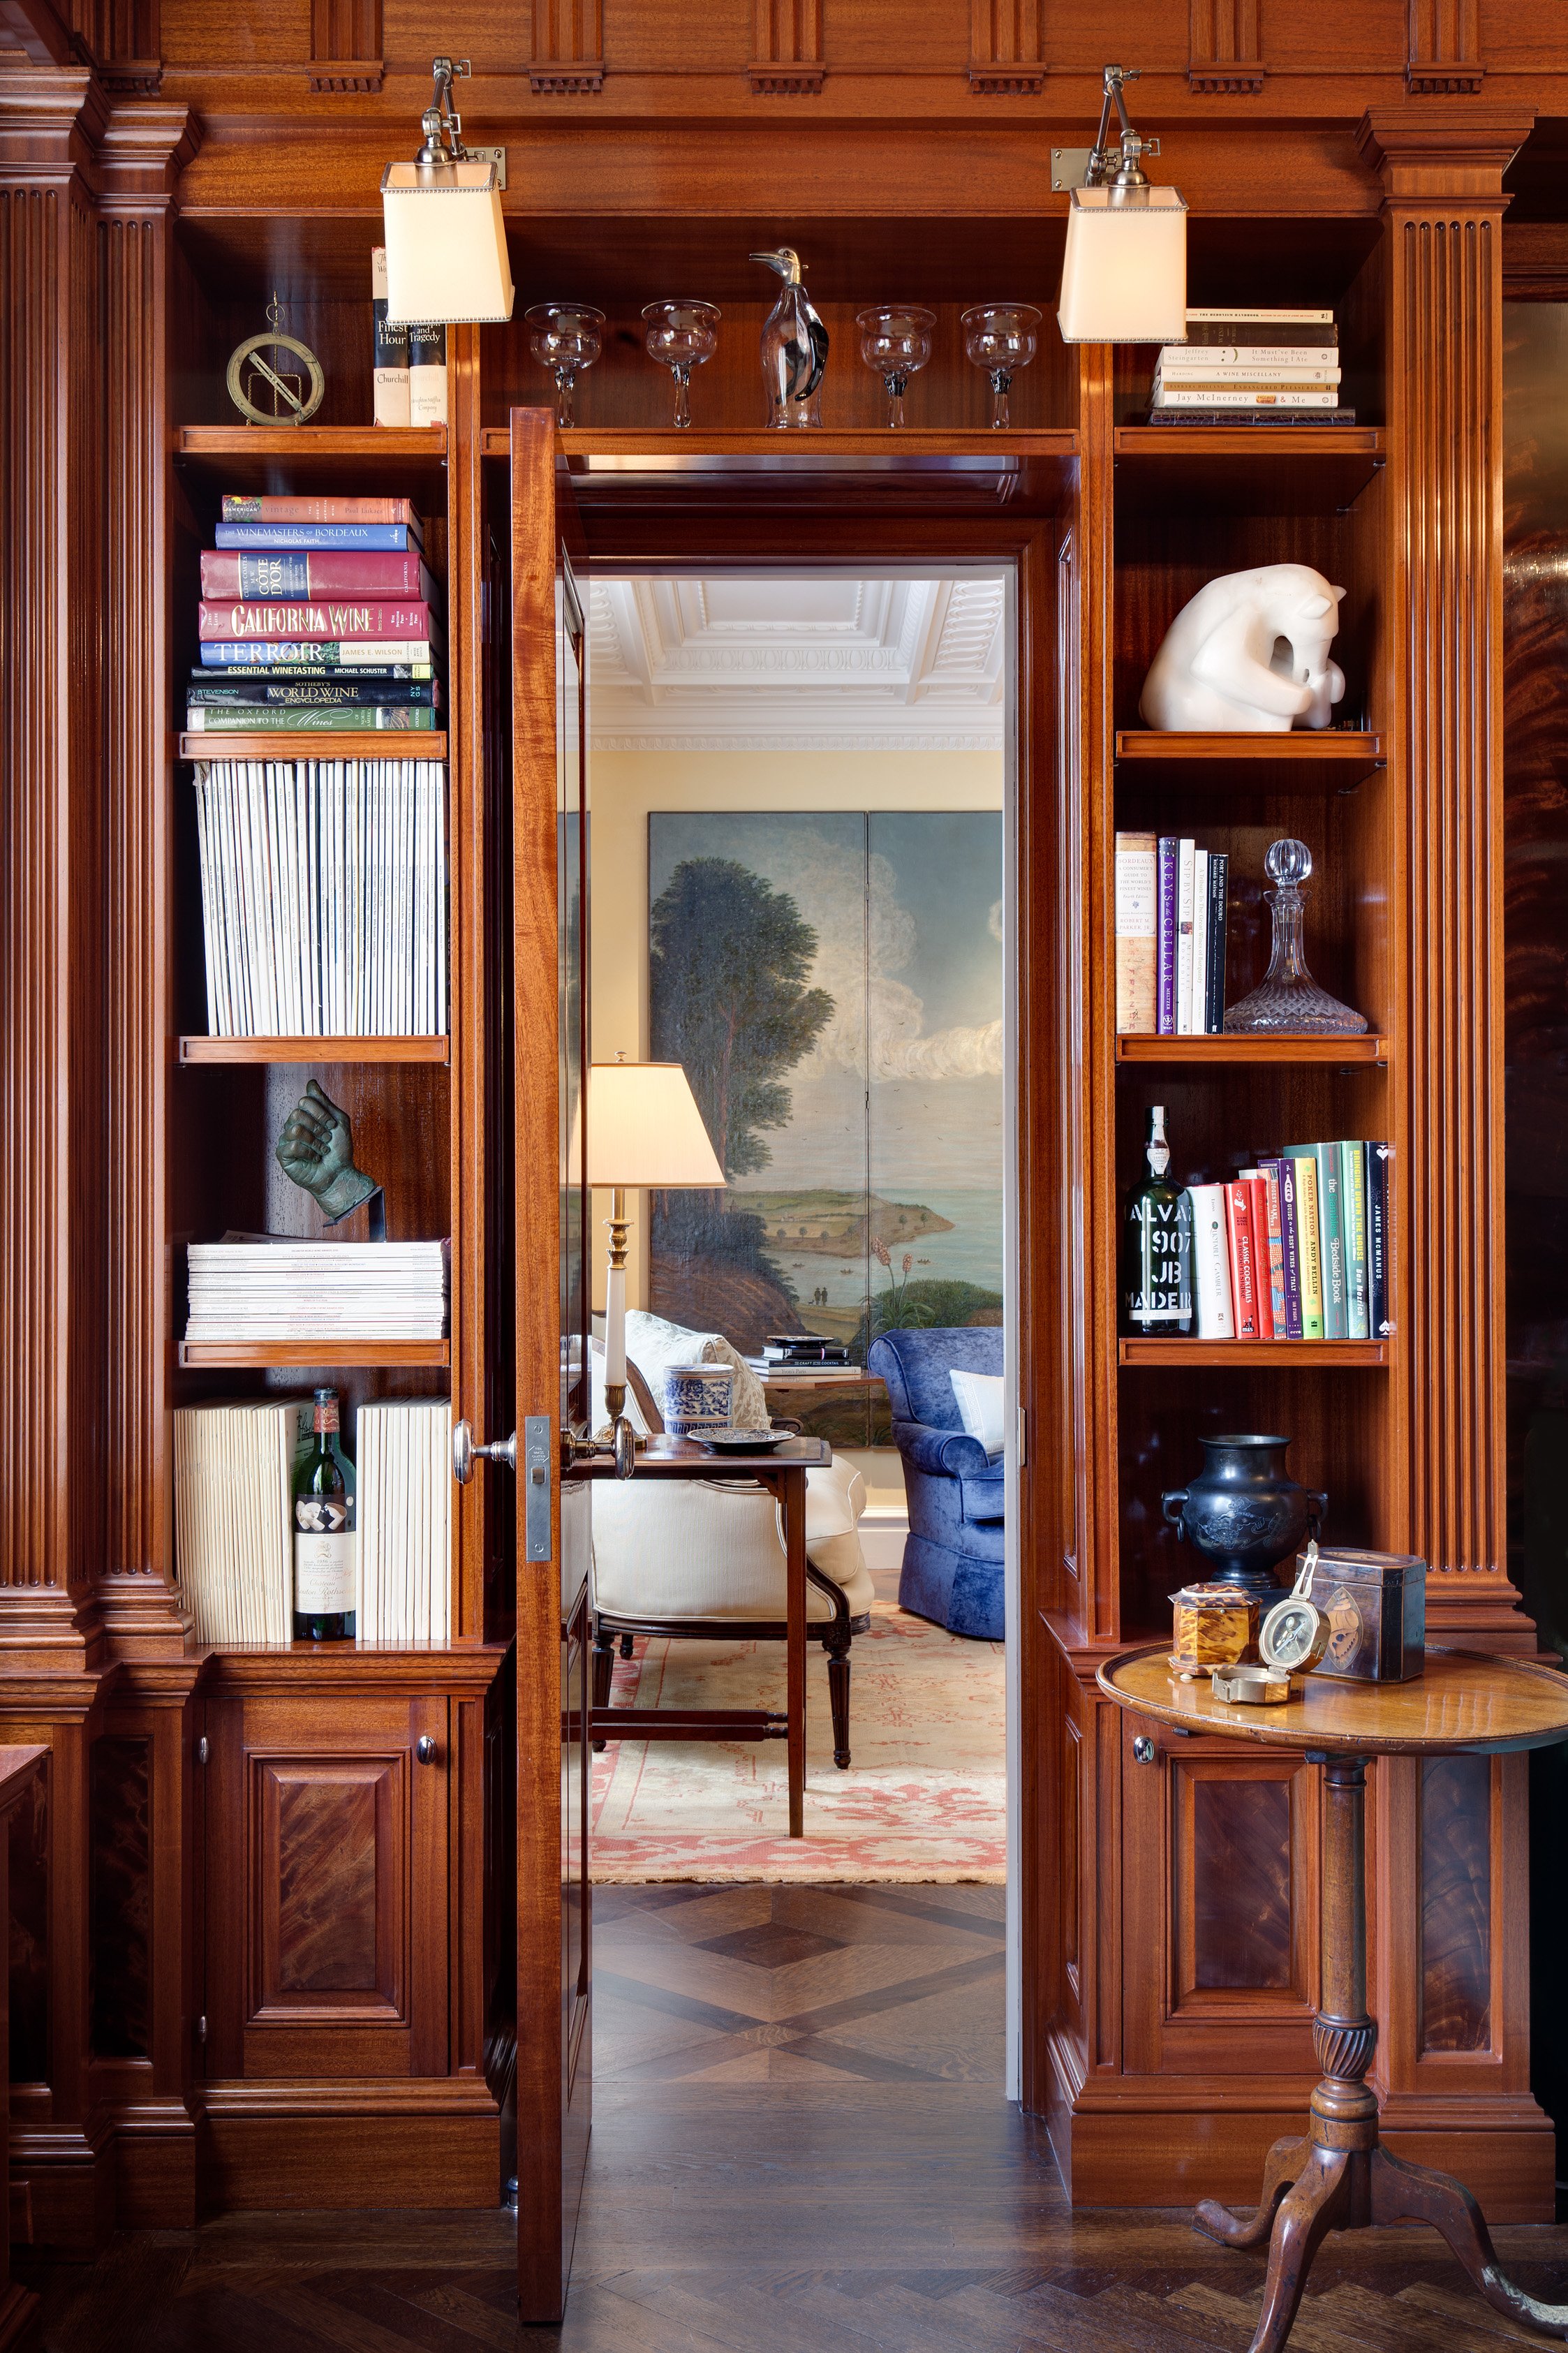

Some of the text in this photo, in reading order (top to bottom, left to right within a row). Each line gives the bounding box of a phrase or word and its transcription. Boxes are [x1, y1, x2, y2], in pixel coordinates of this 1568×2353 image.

[379, 333, 406, 345] Hour
[409, 331, 441, 343] Tragedy
[377, 374, 409, 384] Churchill
[1176, 393, 1192, 403] Jay
[1197, 394, 1249, 404] McInerney
[265, 506, 300, 517] vintage
[236, 529, 306, 537] WINEMASTERS
[315, 529, 369, 538] BORDEAUX
[255, 558, 269, 596] CÔTE
[269, 558, 283, 596] D'OR
[230, 605, 328, 637] CALIFORNIA
[328, 605, 374, 637] WINE
[214, 643, 325, 662] TERROIR
[228, 666, 327, 674] ESSENTIAL WINETASTING
[268, 687, 360, 698] WORLD WINE
[410, 686, 415, 698] NY
[1163, 861, 1174, 901] KEYS
[1183, 860, 1193, 916] SIP BY SIP
[1163, 917, 1173, 982] CELLAR
[1353, 1150, 1361, 1189] BRINGING
[1328, 1179, 1338, 1193] the
[1141, 1230, 1191, 1253] 1907
[1356, 1235, 1364, 1261] HOUSE
[1330, 1238, 1340, 1278] Bedside
[1151, 1261, 1182, 1283] JB
[1242, 1236, 1252, 1304] CLASSIC COCKTAILS
[1331, 1278, 1342, 1304] Book
